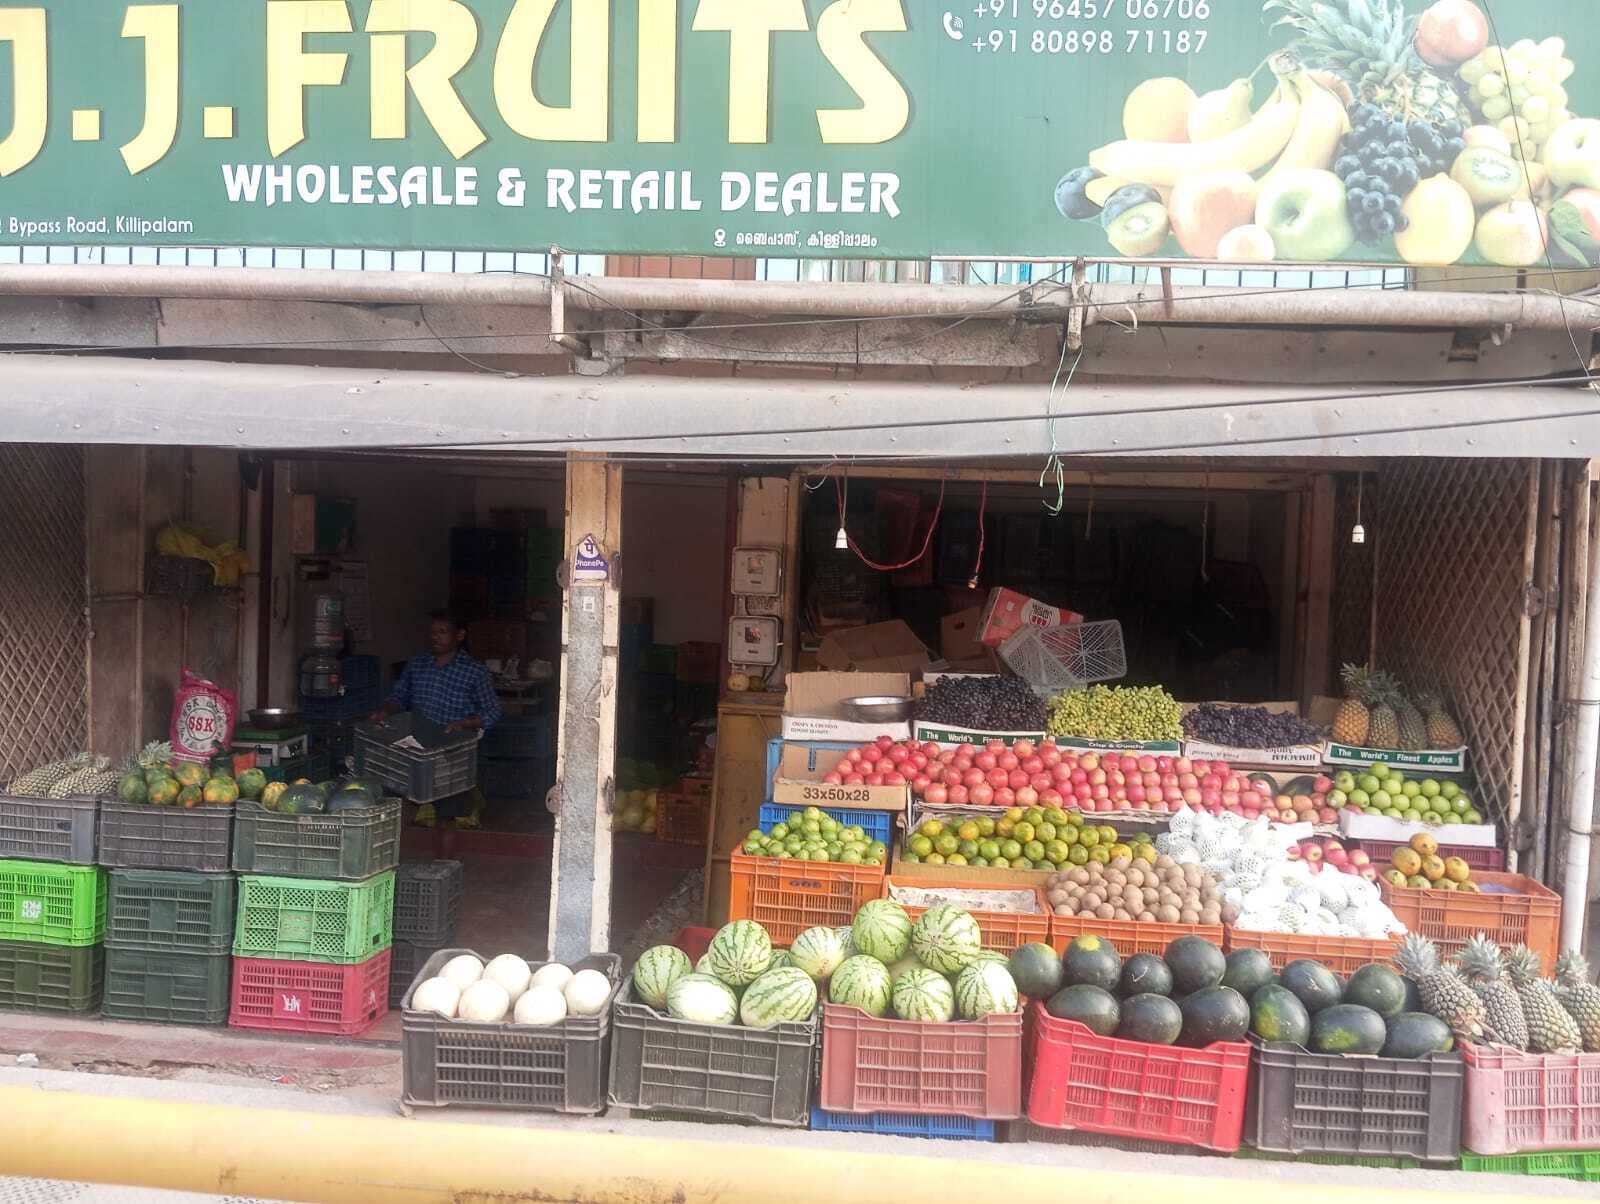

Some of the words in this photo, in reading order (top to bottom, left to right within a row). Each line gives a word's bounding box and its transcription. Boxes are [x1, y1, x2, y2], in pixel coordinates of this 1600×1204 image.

[1126, 0, 1210, 19] 06706
[971, 30, 1017, 52] +91
[1031, 30, 1113, 53] 80898
[1126, 30, 1208, 53] 71187
[222, 164, 478, 208] WHOLESALE
[497, 168, 526, 207] &
[546, 169, 702, 213] RETAIL
[720, 171, 901, 218] DEALER
[9, 216, 61, 237] Bypass
[66, 216, 110, 234] Road,
[116, 215, 194, 237] Killipalam
[188, 716, 214, 733] SSK
[925, 730, 939, 741] The
[947, 733, 974, 743] World's
[1337, 748, 1352, 757] The
[1360, 750, 1389, 760] World's
[1396, 753, 1421, 763] Finest
[1427, 755, 1454, 765] Apples
[803, 787, 870, 801] 33x50x28
